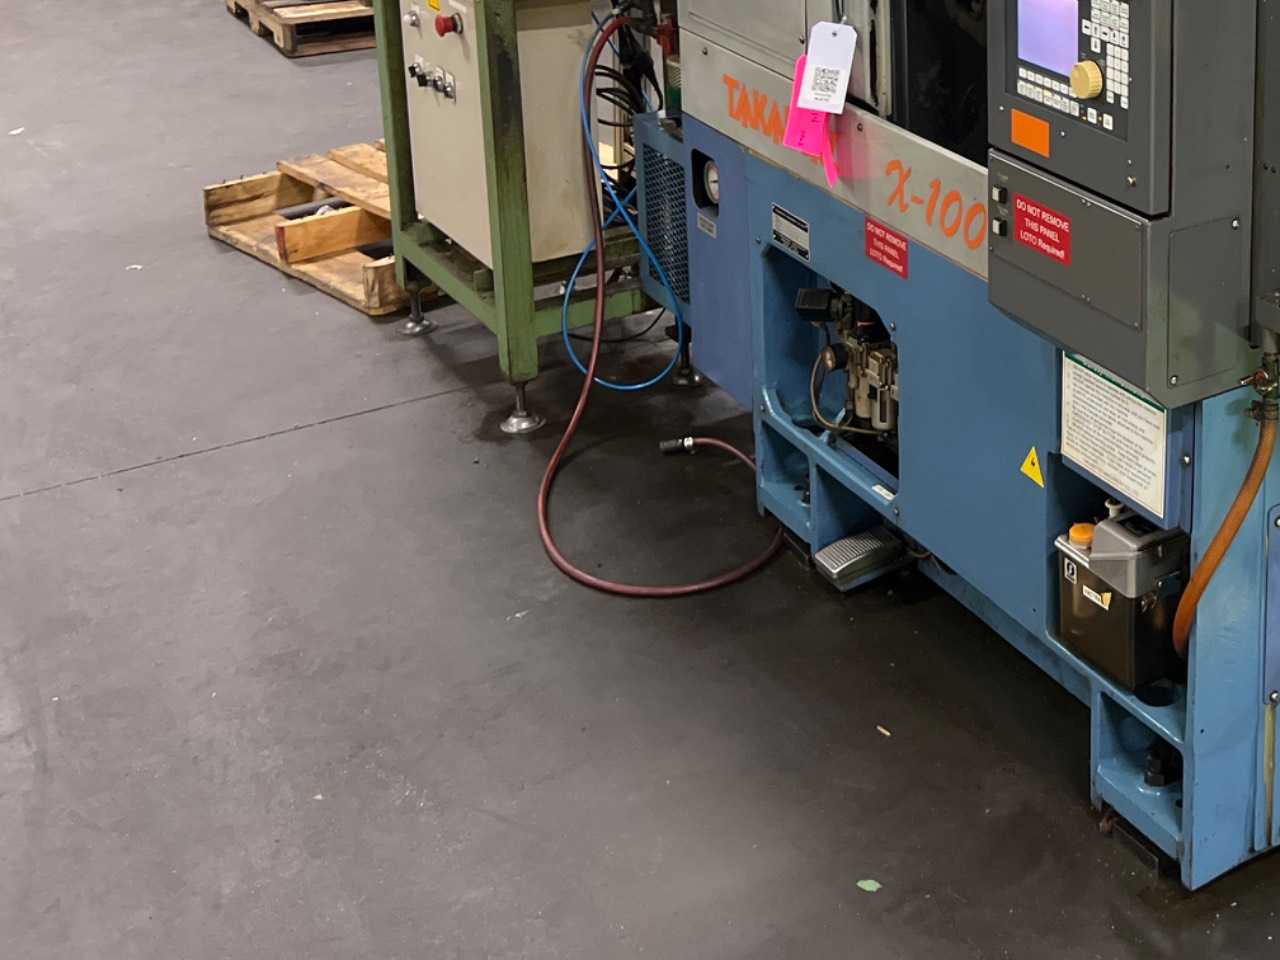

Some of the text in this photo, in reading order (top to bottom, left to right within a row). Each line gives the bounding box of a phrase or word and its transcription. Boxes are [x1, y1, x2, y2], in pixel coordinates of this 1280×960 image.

[1016, 198, 1070, 233] DO NOT REMOVE
[1020, 229, 1037, 246] LOTO
[1024, 217, 1060, 243] THIS PANEL
